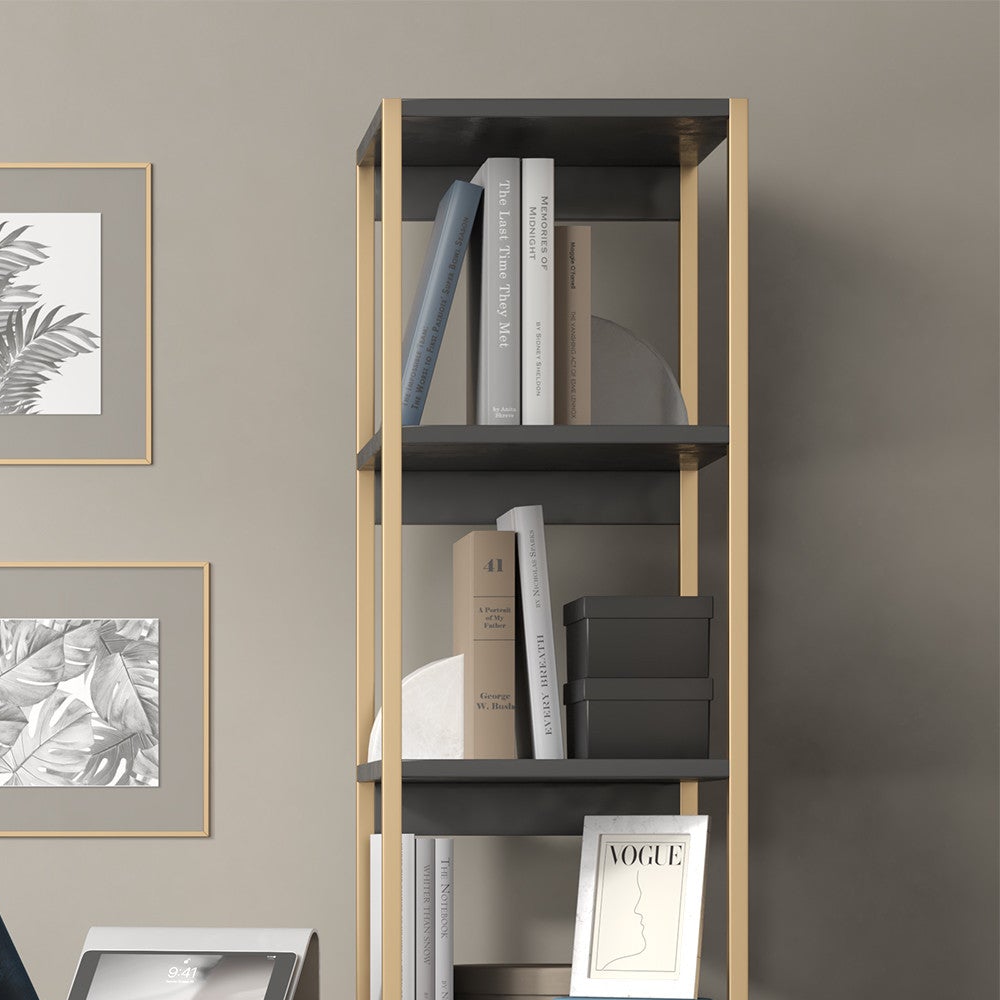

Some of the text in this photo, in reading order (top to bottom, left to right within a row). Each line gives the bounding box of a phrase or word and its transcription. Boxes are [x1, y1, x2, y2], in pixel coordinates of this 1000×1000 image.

[496, 180, 510, 348] The Last Time They Met
[482, 558, 504, 572] 41
[536, 634, 552, 736] EVERY BREATH
[480, 692, 511, 700] George
[609, 844, 682, 866] VOGUE
[168, 966, 198, 978] 9:41
